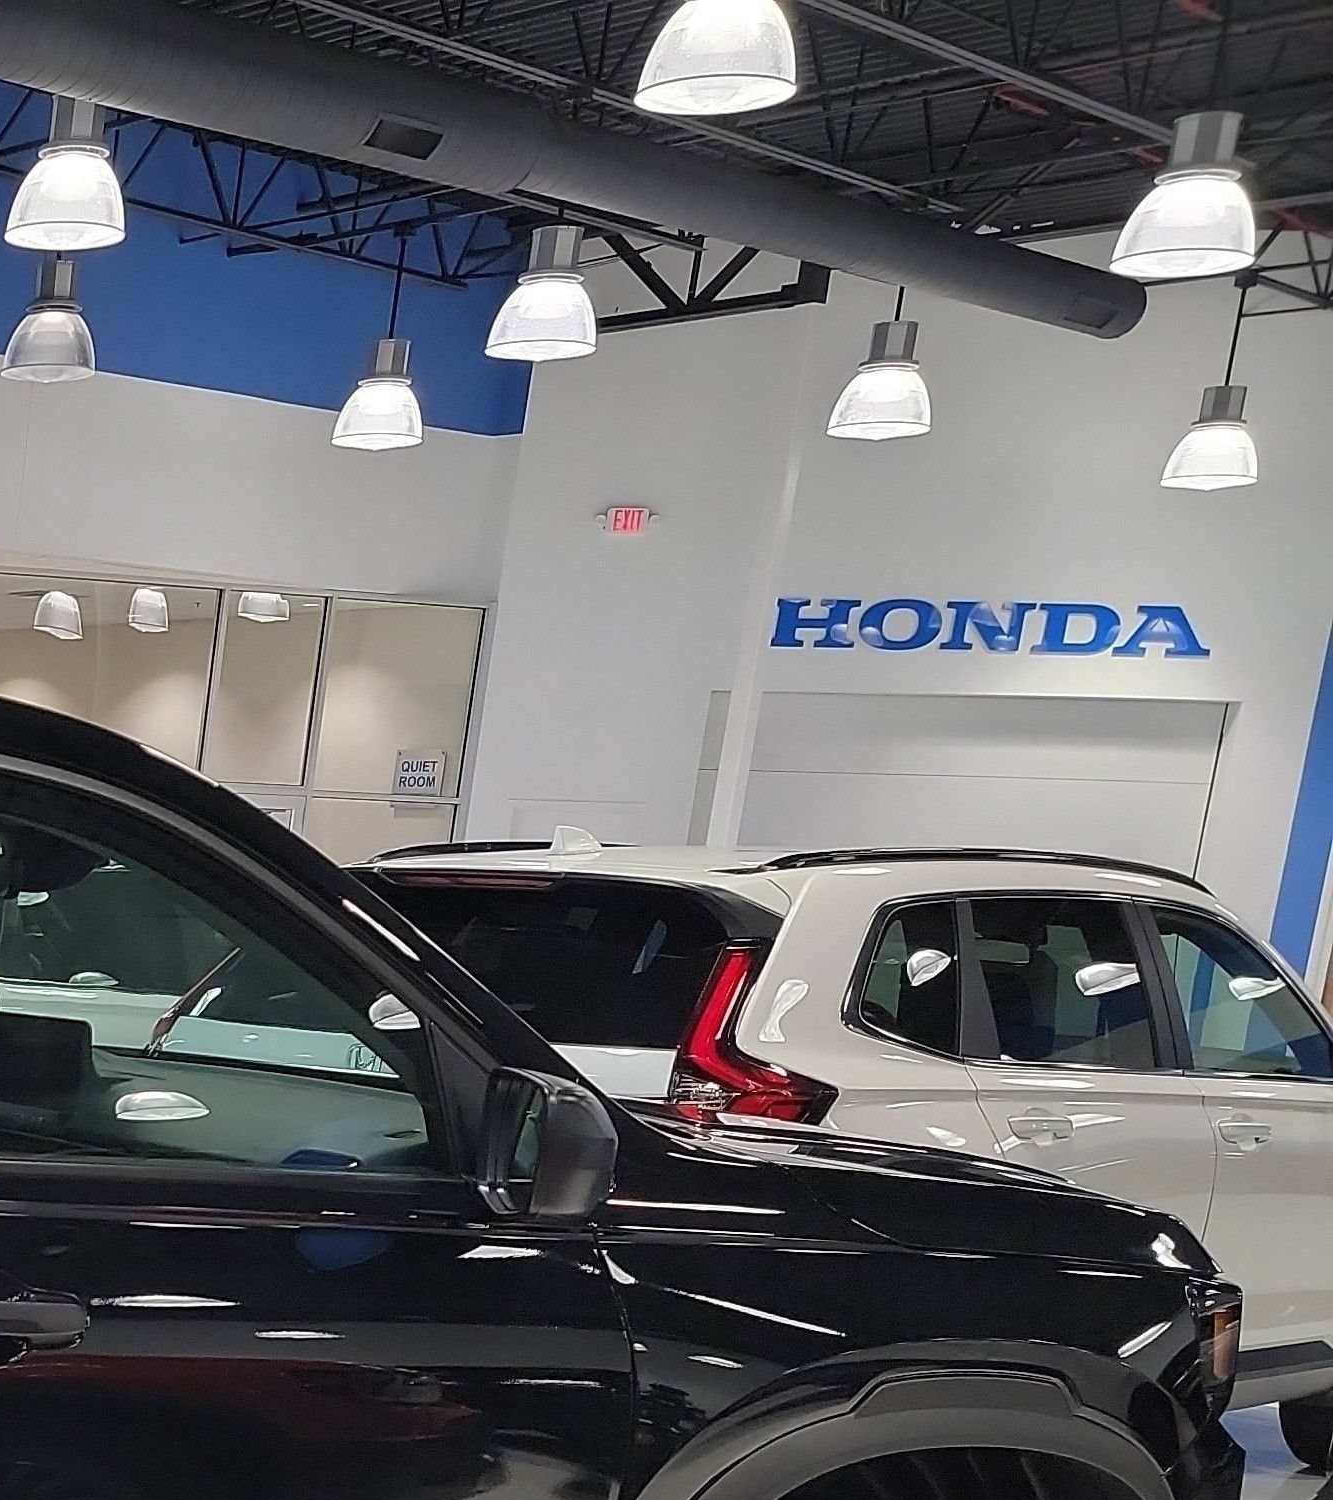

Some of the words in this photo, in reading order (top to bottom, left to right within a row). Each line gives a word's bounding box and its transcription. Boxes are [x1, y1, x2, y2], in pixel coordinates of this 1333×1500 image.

[613, 509, 645, 531] EXIT
[770, 597, 1210, 658] HONDA
[401, 760, 439, 773] QUIET
[398, 775, 437, 788] ROOM
